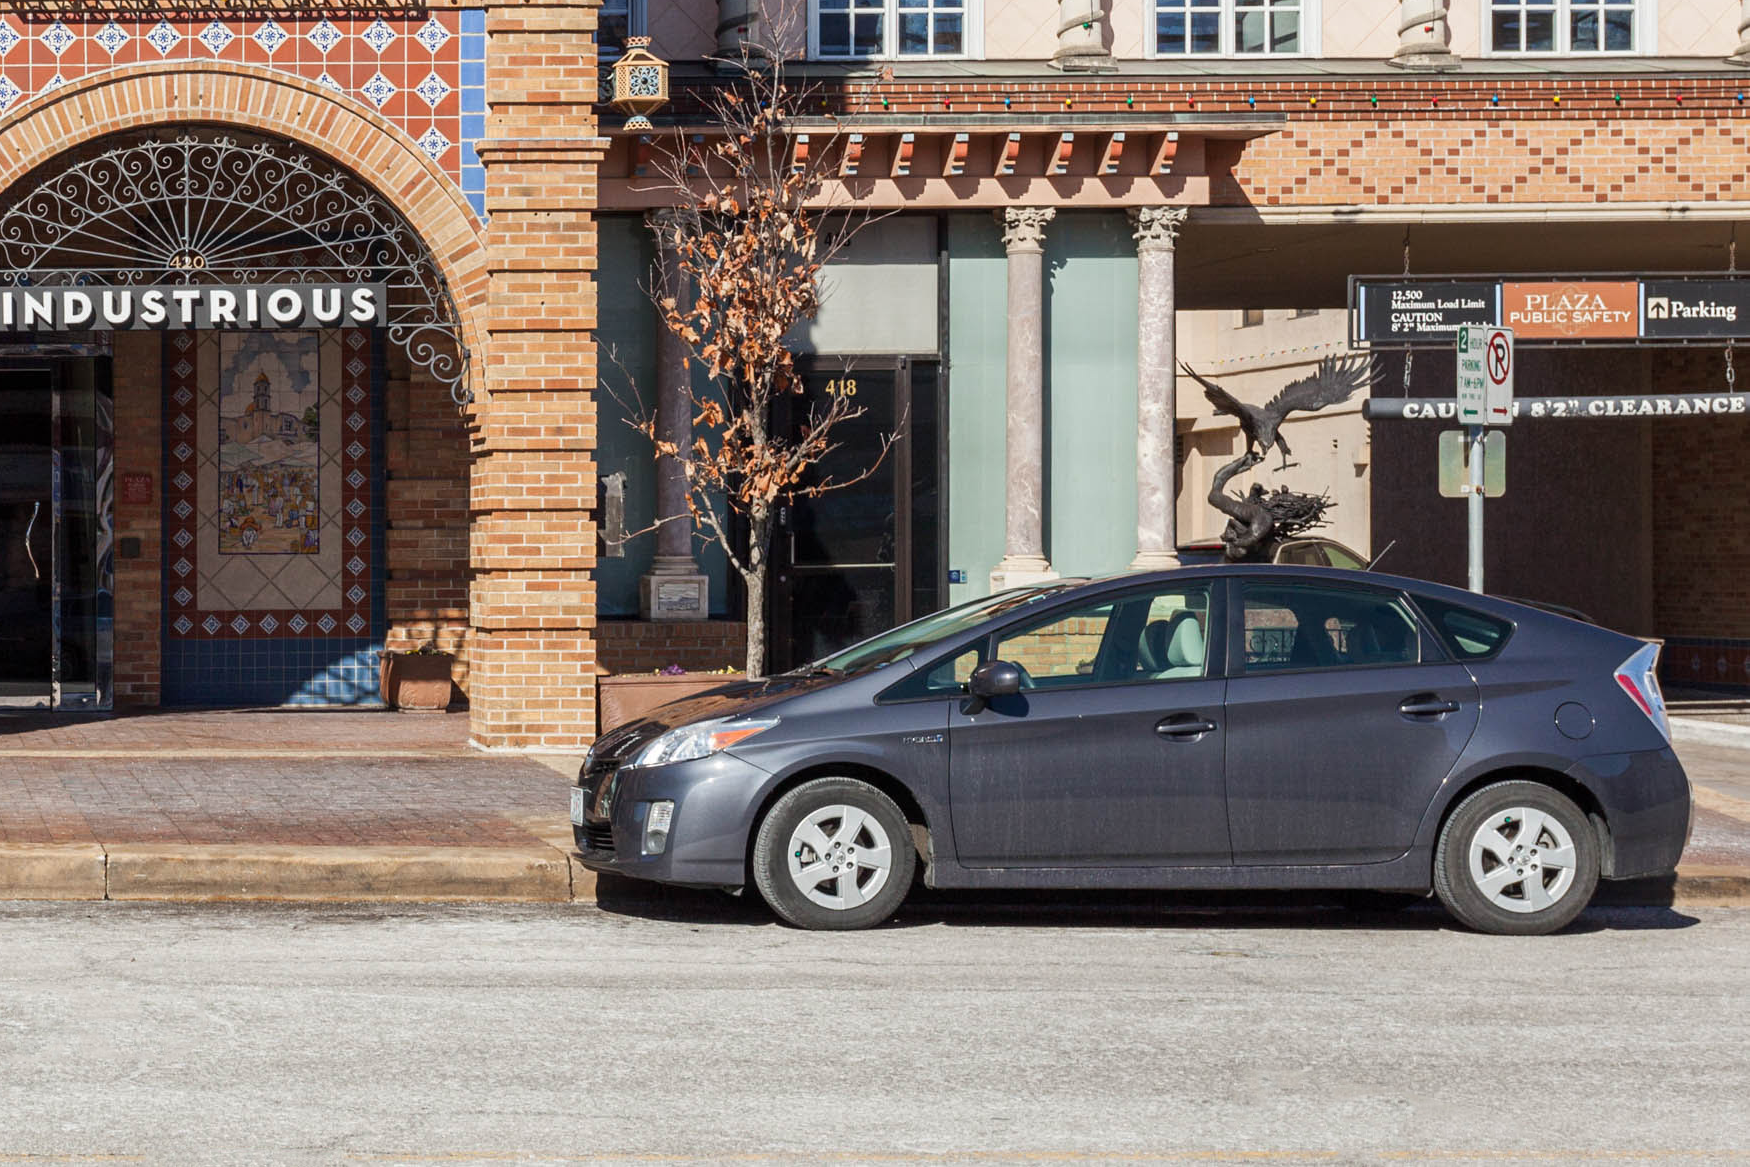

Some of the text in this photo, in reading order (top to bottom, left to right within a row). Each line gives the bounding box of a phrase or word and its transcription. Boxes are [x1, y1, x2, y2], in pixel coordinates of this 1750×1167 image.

[169, 255, 205, 270] 420
[1392, 290, 1423, 301] 12,500
[1524, 293, 1608, 311] PLAZA
[2, 287, 377, 325] INDUSTRIOUS
[1391, 299, 1486, 309] Maximum Load Limit
[1671, 300, 1737, 322] Parking
[1391, 312, 1443, 323] CAUTION
[1510, 311, 1632, 323] PUBLIC SAFETY
[1391, 322, 1401, 332] 8'
[1460, 331, 1467, 349] 2
[825, 379, 857, 396] 418
[1530, 400, 1579, 417] 8'2"
[1588, 396, 1746, 417] CLEARANCE
